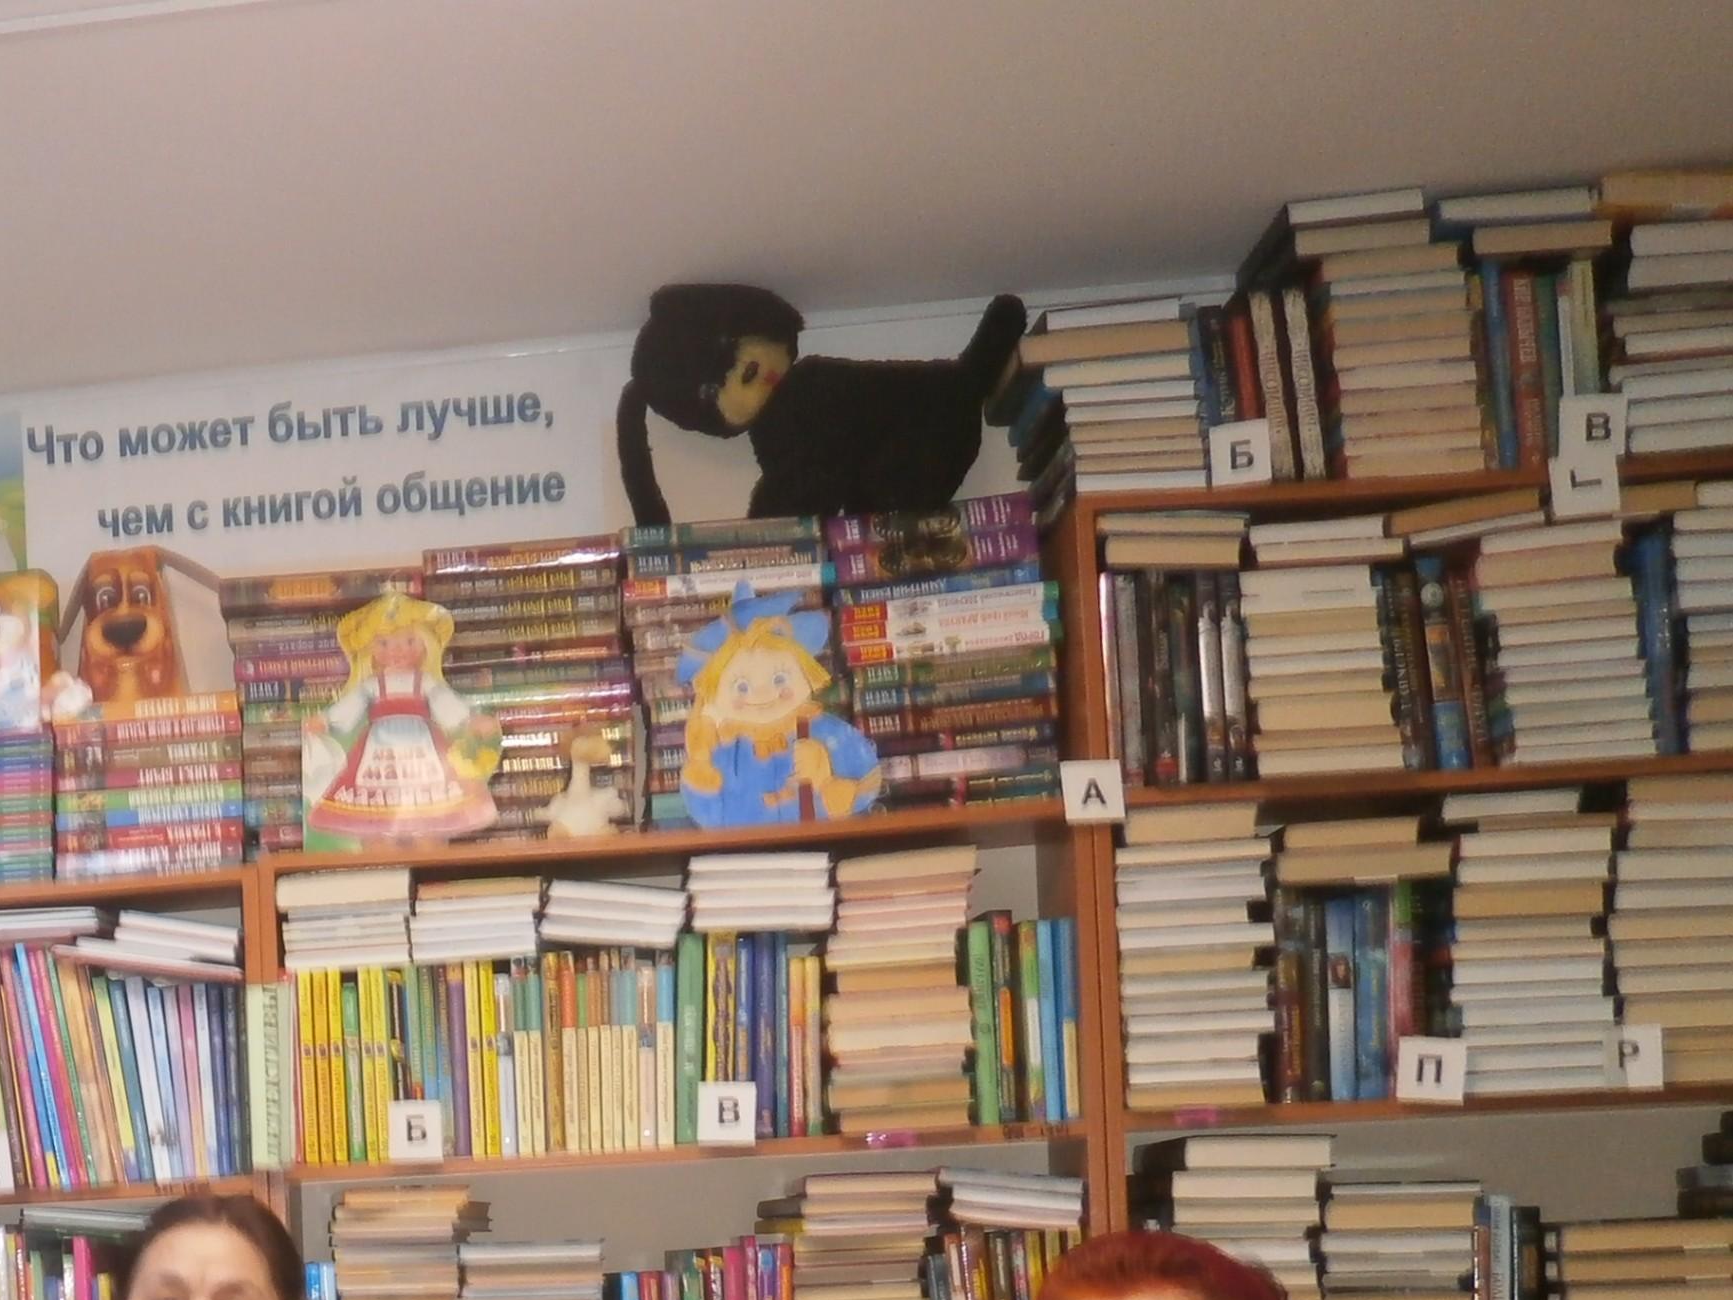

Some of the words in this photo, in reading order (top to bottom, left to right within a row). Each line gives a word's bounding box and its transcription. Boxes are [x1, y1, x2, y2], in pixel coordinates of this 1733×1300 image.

[28, 424, 104, 466] Что
[119, 415, 255, 458] может
[268, 402, 383, 444] быть
[397, 391, 554, 441] лучше,
[1586, 412, 1611, 441] В
[1229, 441, 1254, 469] Б
[98, 501, 174, 538] чем
[187, 498, 209, 530] с
[222, 475, 363, 528] книгой
[378, 470, 565, 514] общение
[1083, 779, 1107, 808] А
[1416, 1054, 1442, 1084] П
[1618, 1040, 1639, 1069] Р
[718, 1096, 740, 1126] В
[406, 1115, 428, 1142] Б
